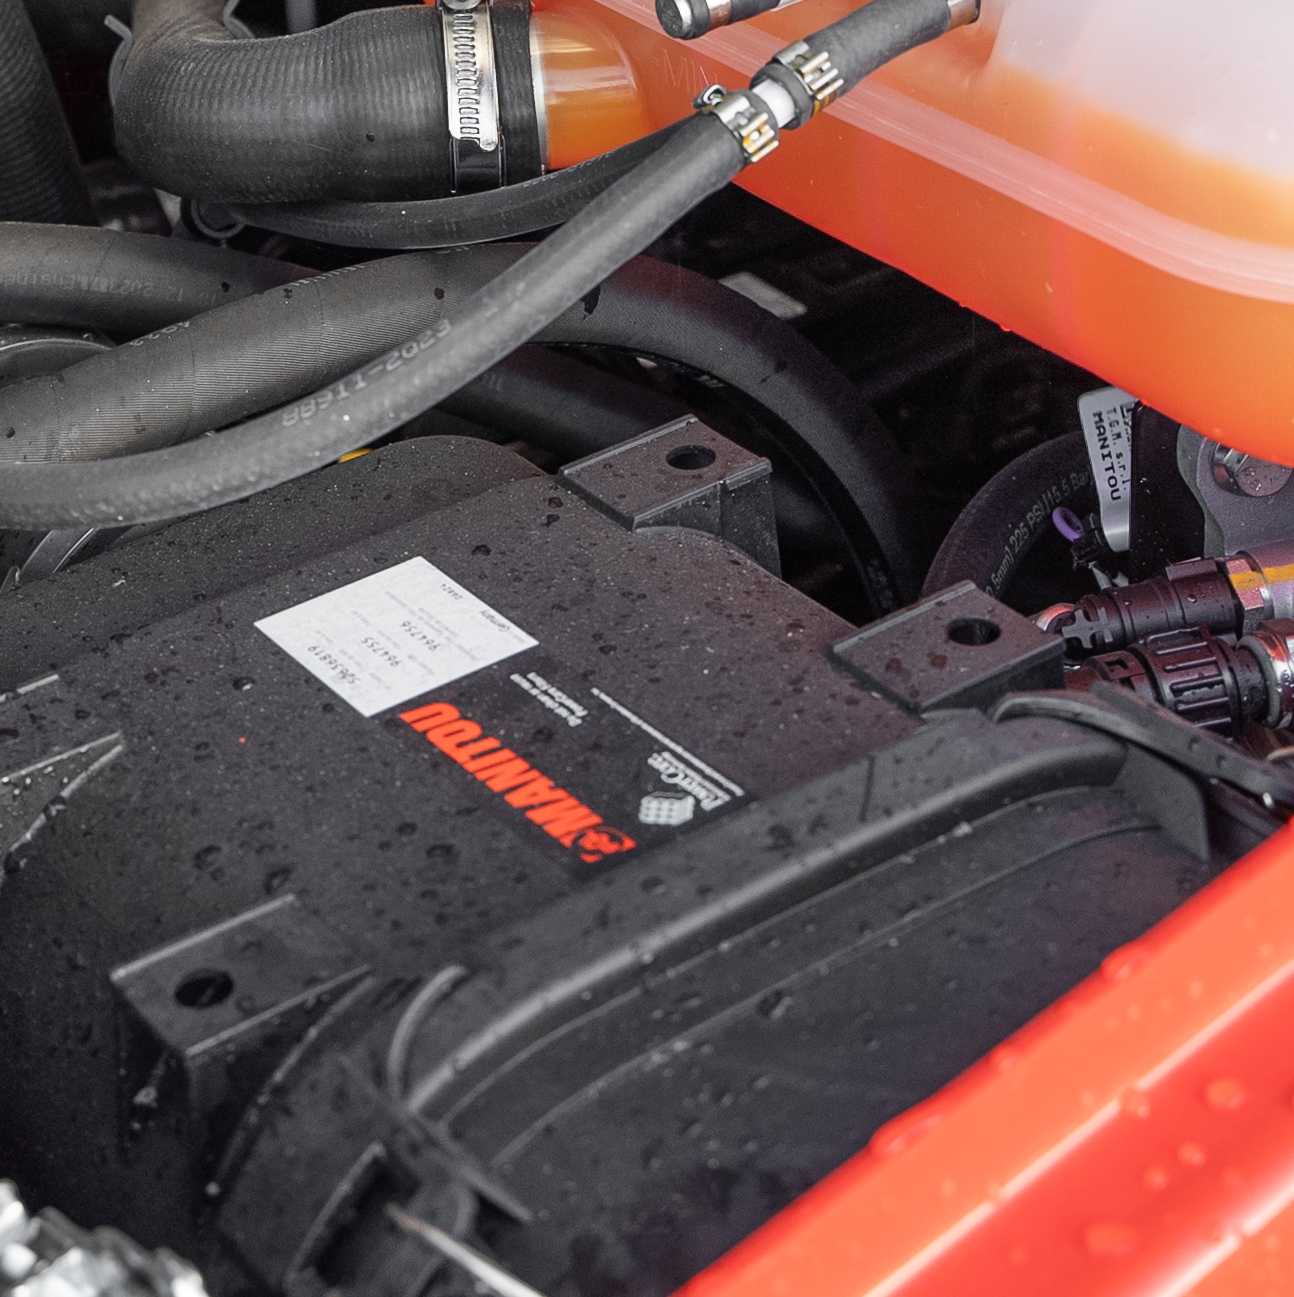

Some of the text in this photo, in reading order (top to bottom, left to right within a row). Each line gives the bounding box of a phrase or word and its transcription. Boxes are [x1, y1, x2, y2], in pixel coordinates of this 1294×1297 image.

[1093, 410, 1122, 502] MANITOU
[360, 636, 401, 668] 964755
[399, 619, 441, 652] 964756
[399, 702, 604, 839] MANITOU
